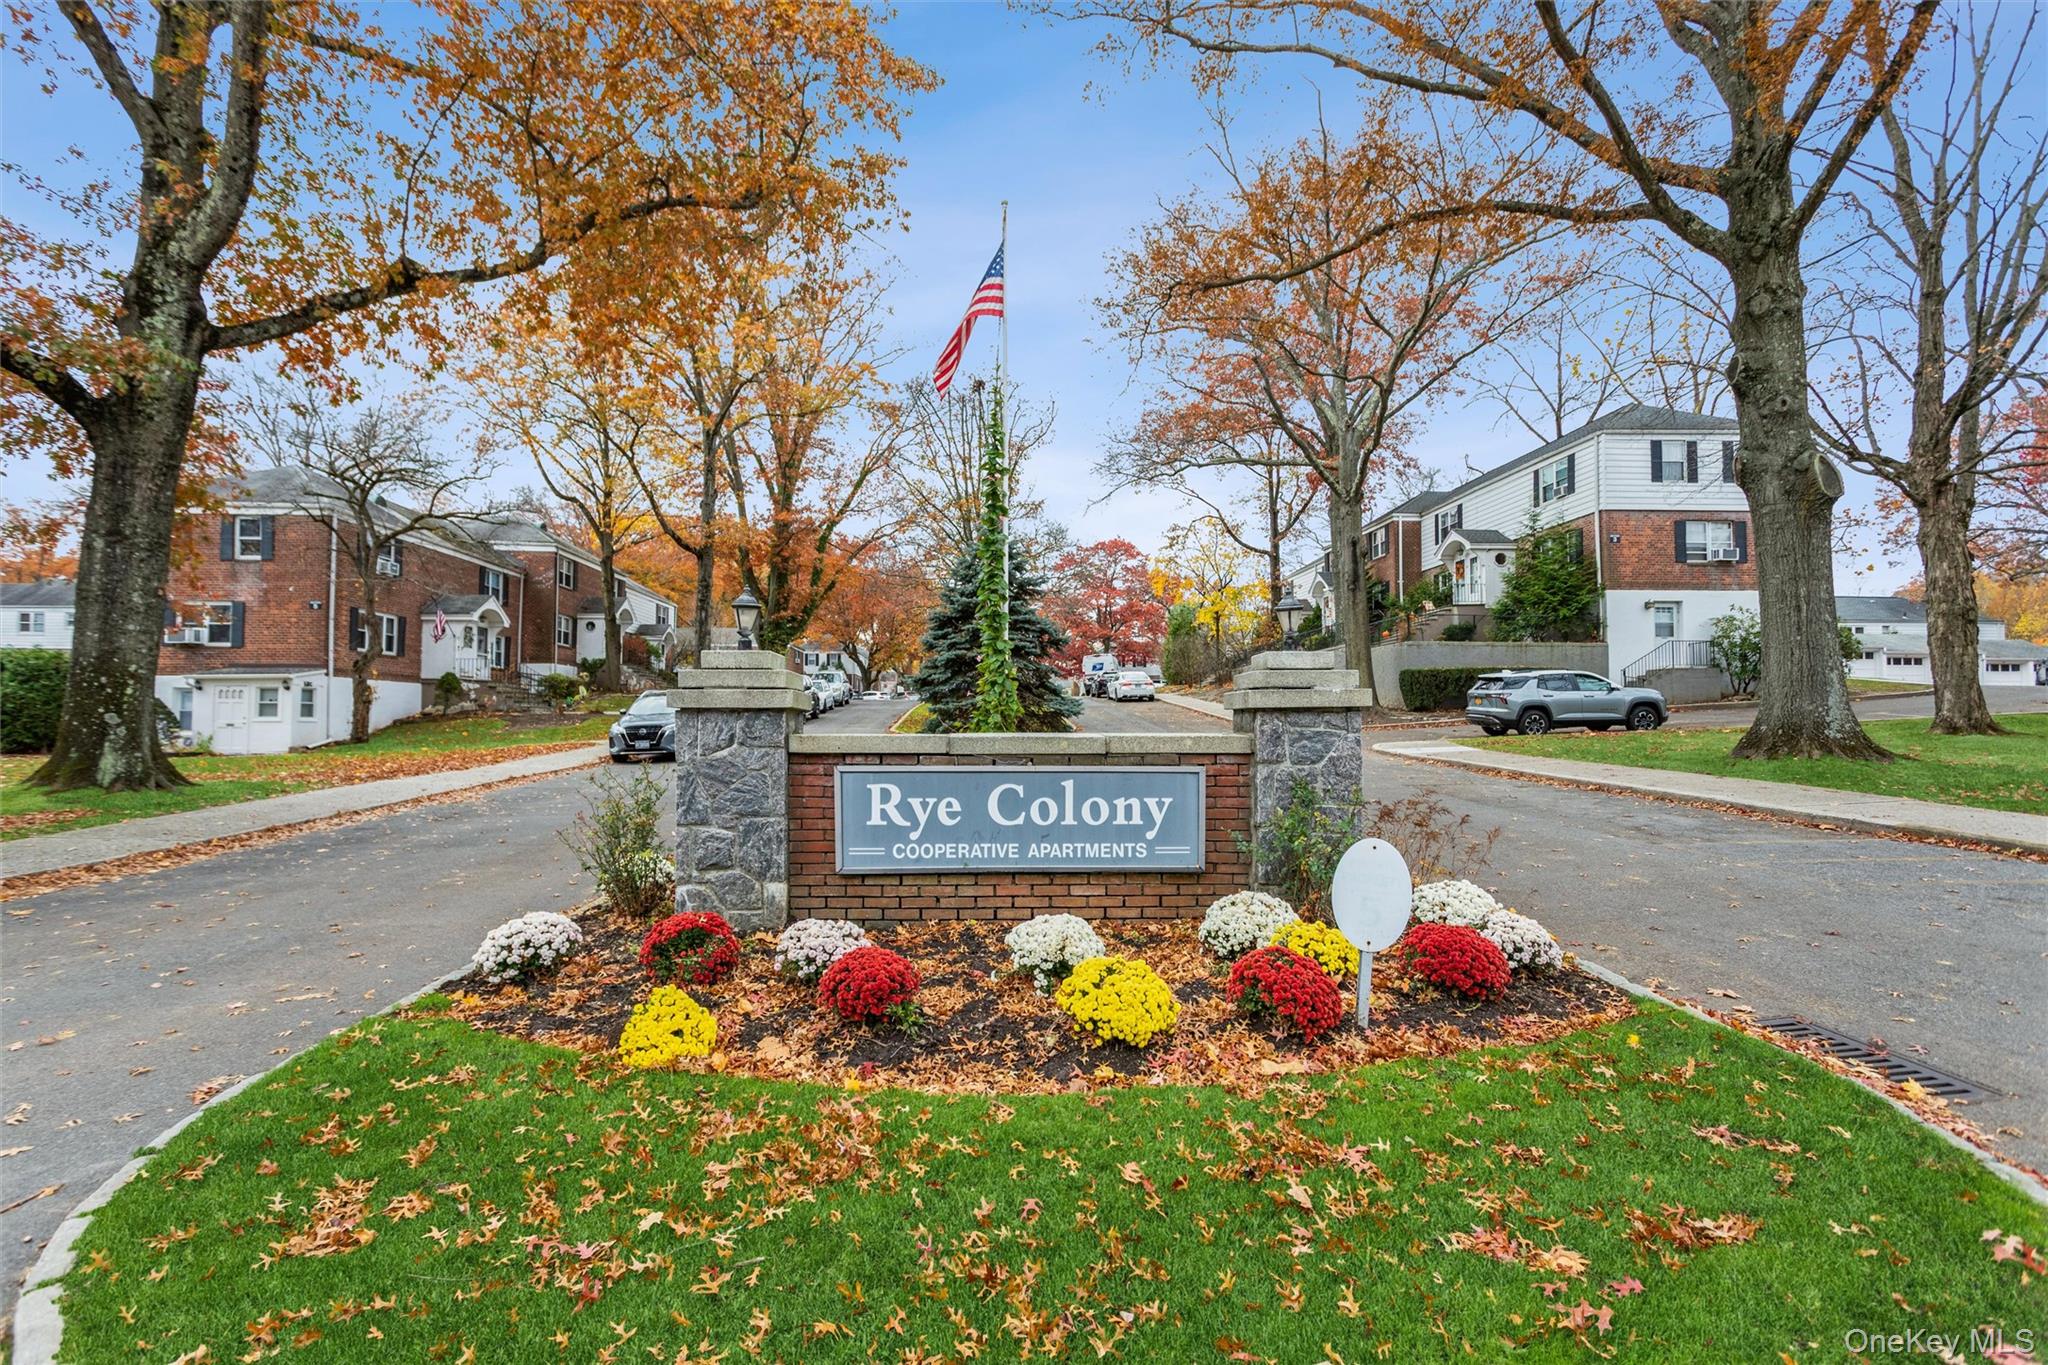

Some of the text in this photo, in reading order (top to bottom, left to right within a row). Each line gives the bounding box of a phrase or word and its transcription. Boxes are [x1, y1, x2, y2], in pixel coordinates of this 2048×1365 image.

[866, 779, 1174, 840] Rye Colony
[892, 842, 1148, 859] COOPERATIVE APARTMENTS
